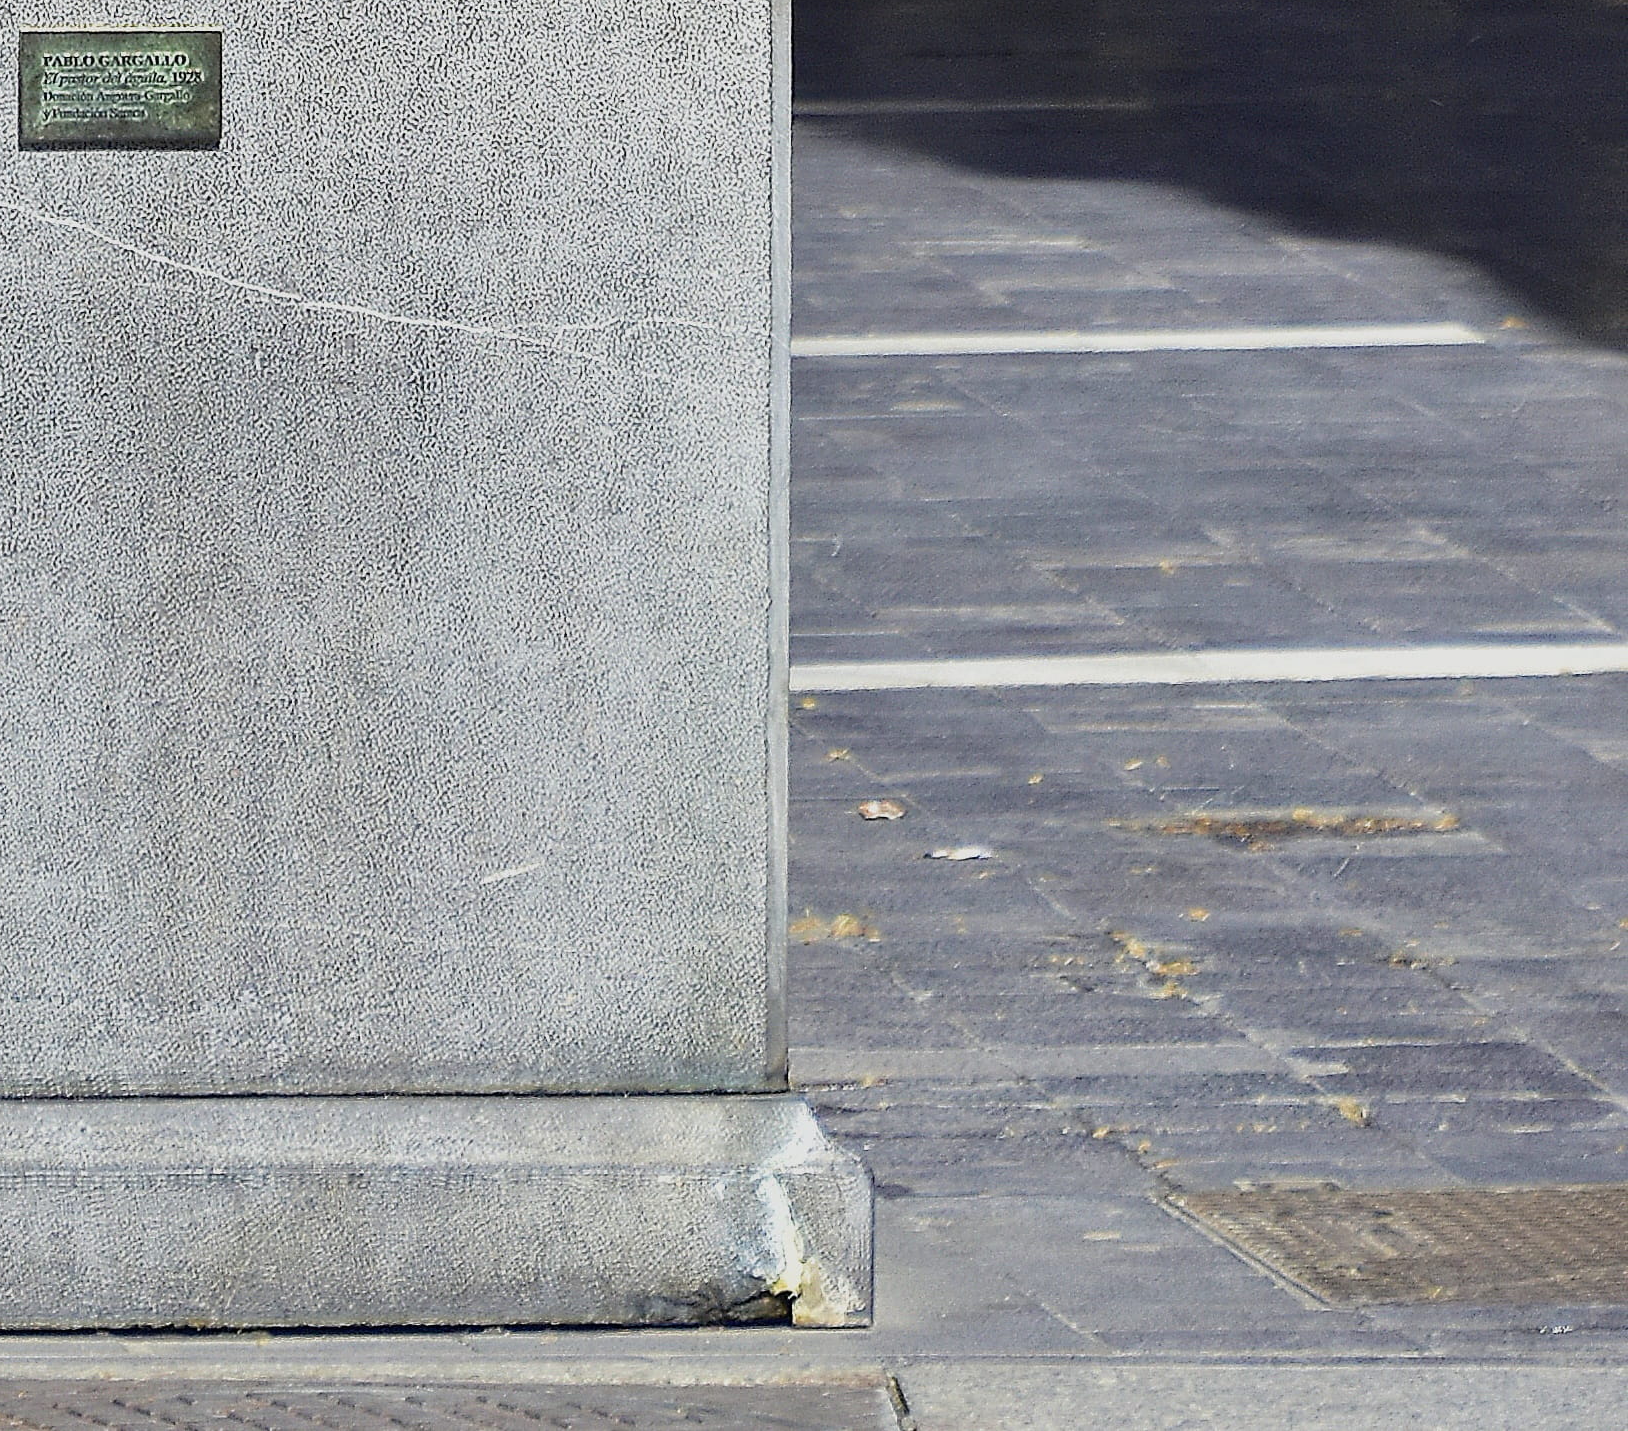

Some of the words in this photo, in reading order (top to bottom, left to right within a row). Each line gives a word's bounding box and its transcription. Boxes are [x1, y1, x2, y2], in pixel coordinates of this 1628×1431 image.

[43, 54, 95, 67] PABLO
[43, 71, 58, 85] El
[59, 72, 99, 87] pastor
[102, 71, 122, 85] del
[171, 70, 203, 85] 1928
[43, 90, 93, 102] Donación
[53, 107, 108, 119] Fundación
